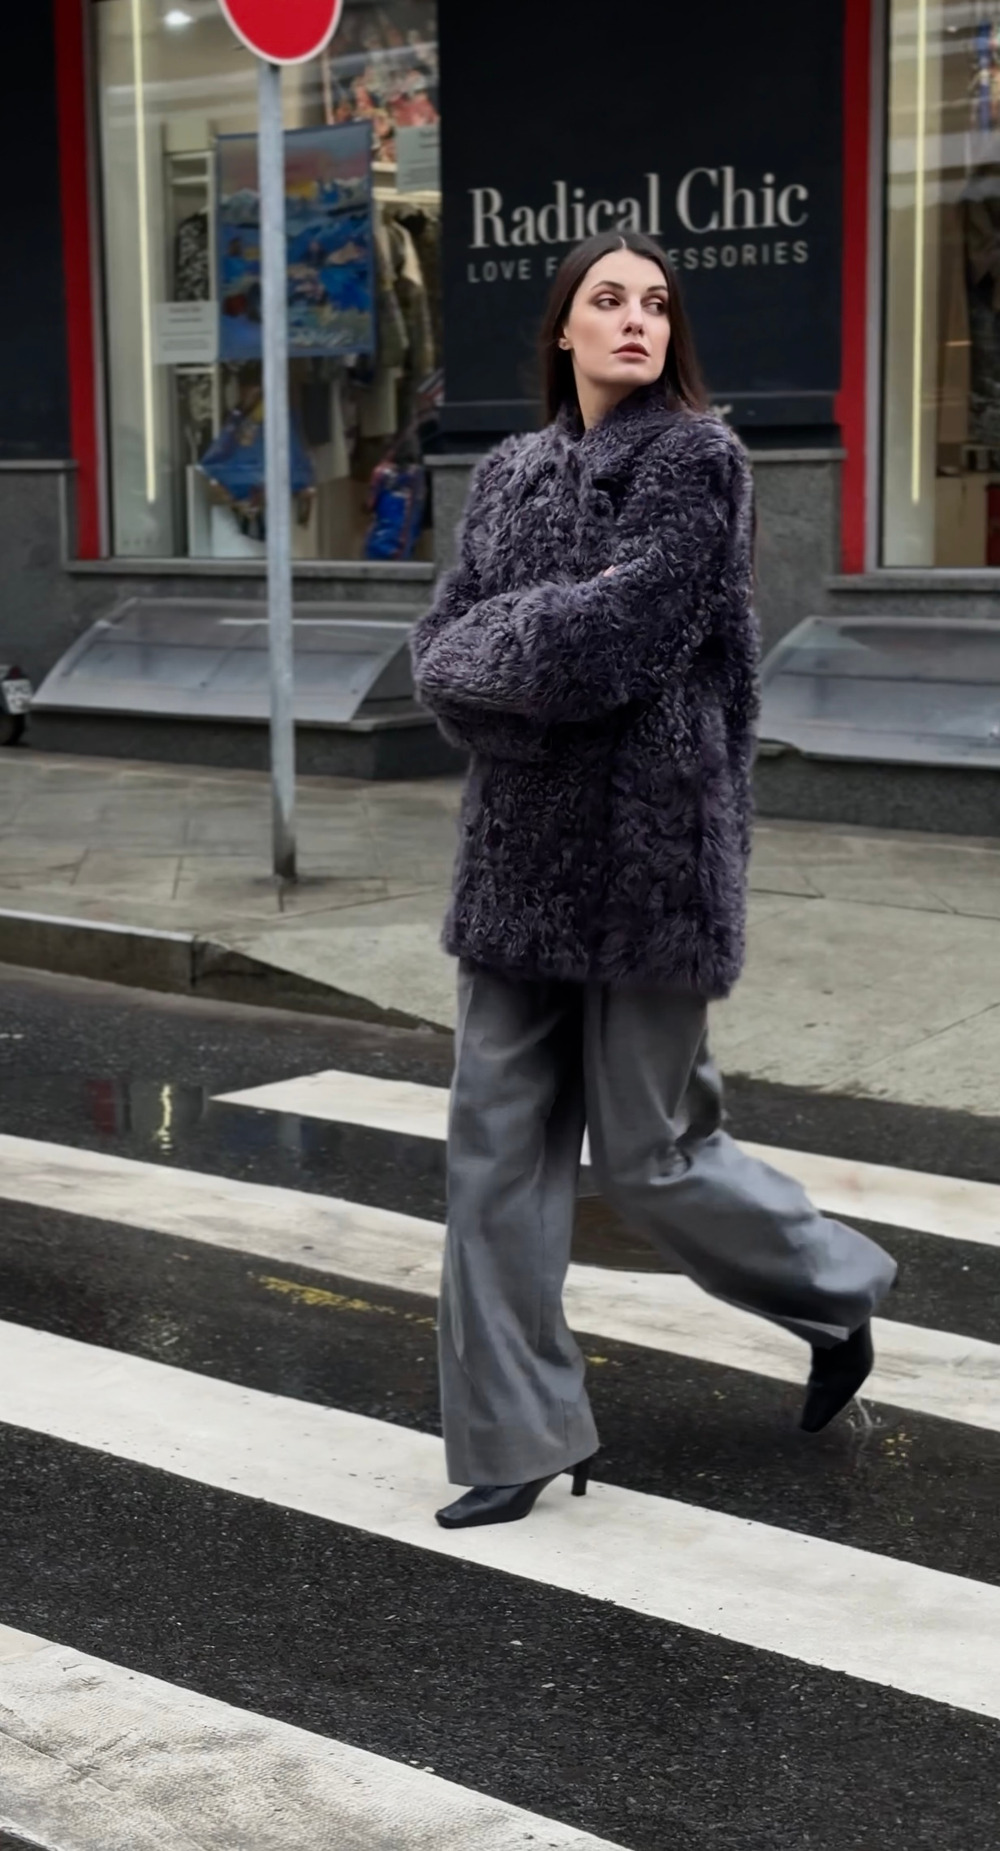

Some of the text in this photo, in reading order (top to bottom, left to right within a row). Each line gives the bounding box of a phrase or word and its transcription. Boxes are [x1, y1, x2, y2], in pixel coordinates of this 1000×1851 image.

[467, 165, 809, 249] Radical Chic
[467, 258, 532, 284] LOVE
[667, 240, 809, 271] ESSORIES
